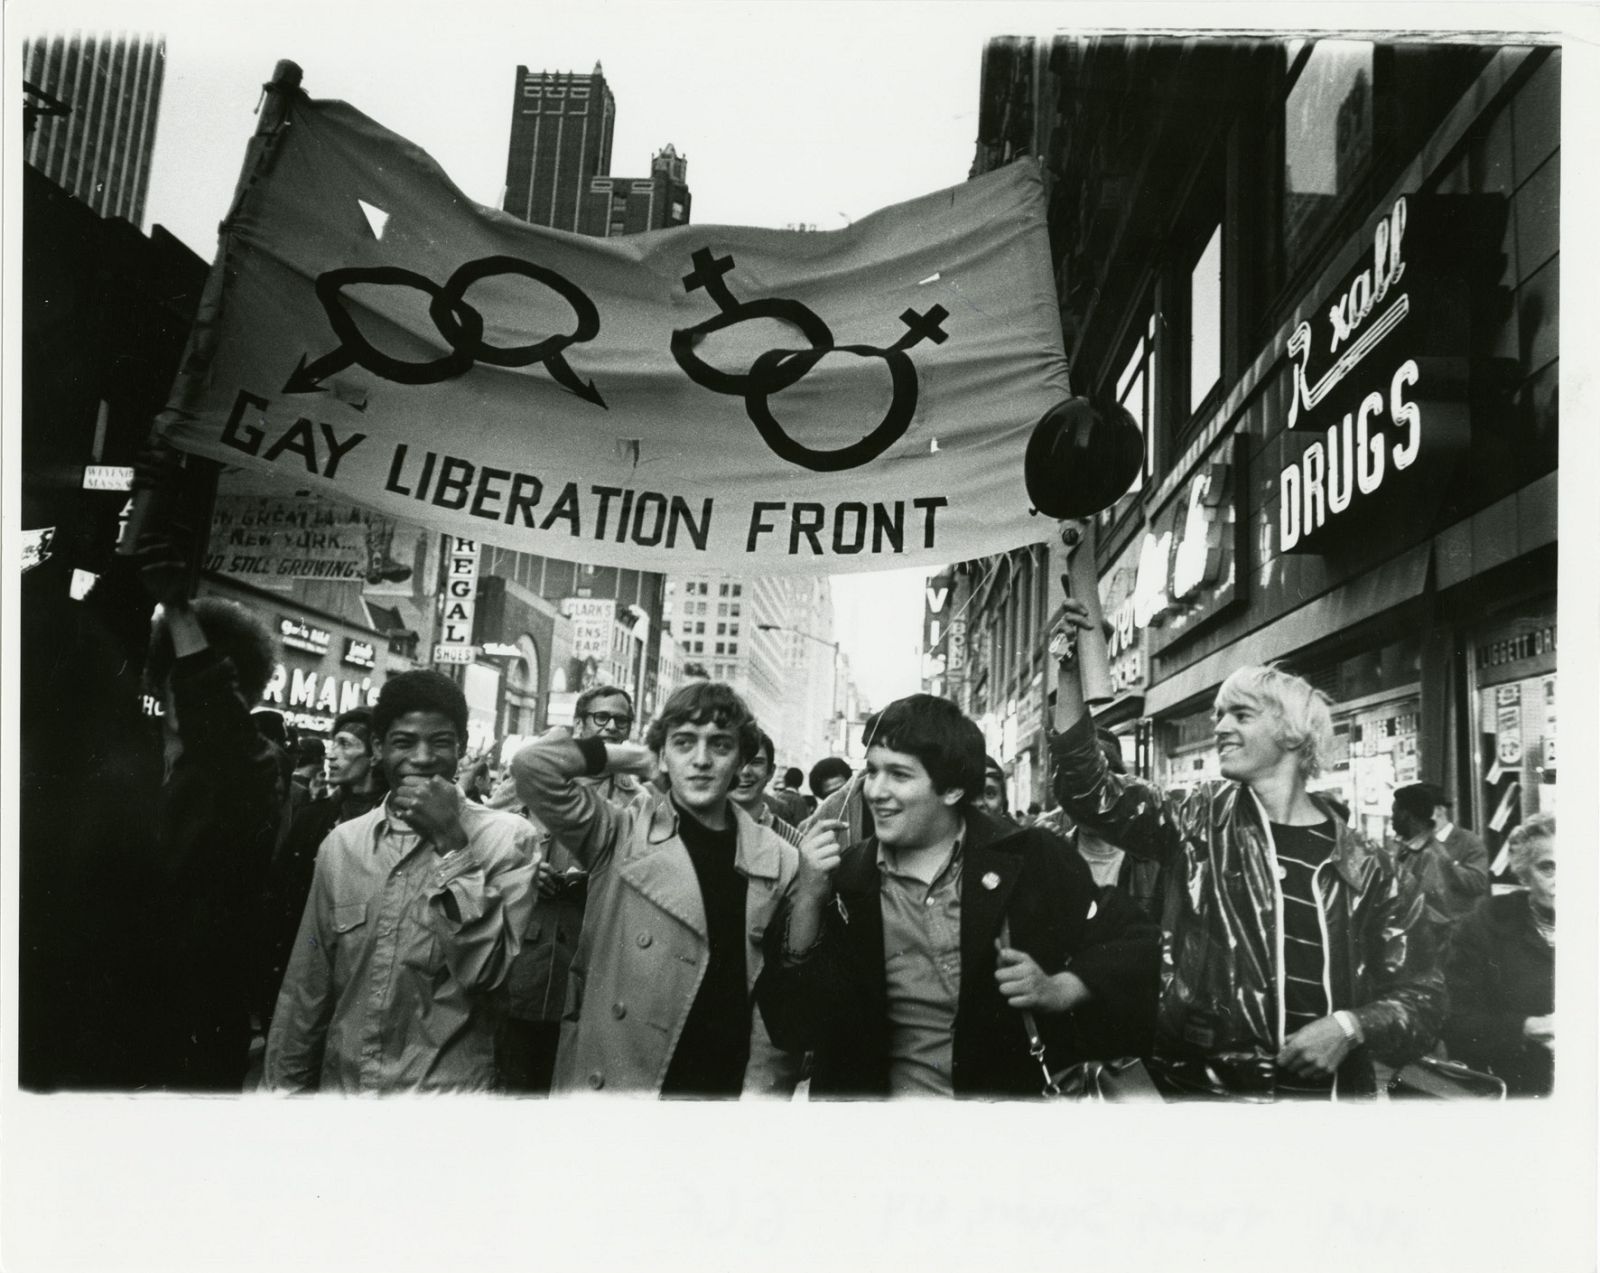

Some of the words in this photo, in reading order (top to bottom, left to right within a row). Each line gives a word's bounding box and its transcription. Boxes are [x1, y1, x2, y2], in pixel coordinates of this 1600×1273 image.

[1288, 197, 1408, 428] Rxall
[219, 388, 367, 480] GAY
[384, 442, 714, 552] LIBERATION
[745, 496, 948, 555] FRONT
[1280, 359, 1420, 553] DRUGS
[228, 555, 271, 575] STILL
[230, 528, 270, 548] NEW
[435, 647, 471, 662] SHOES
